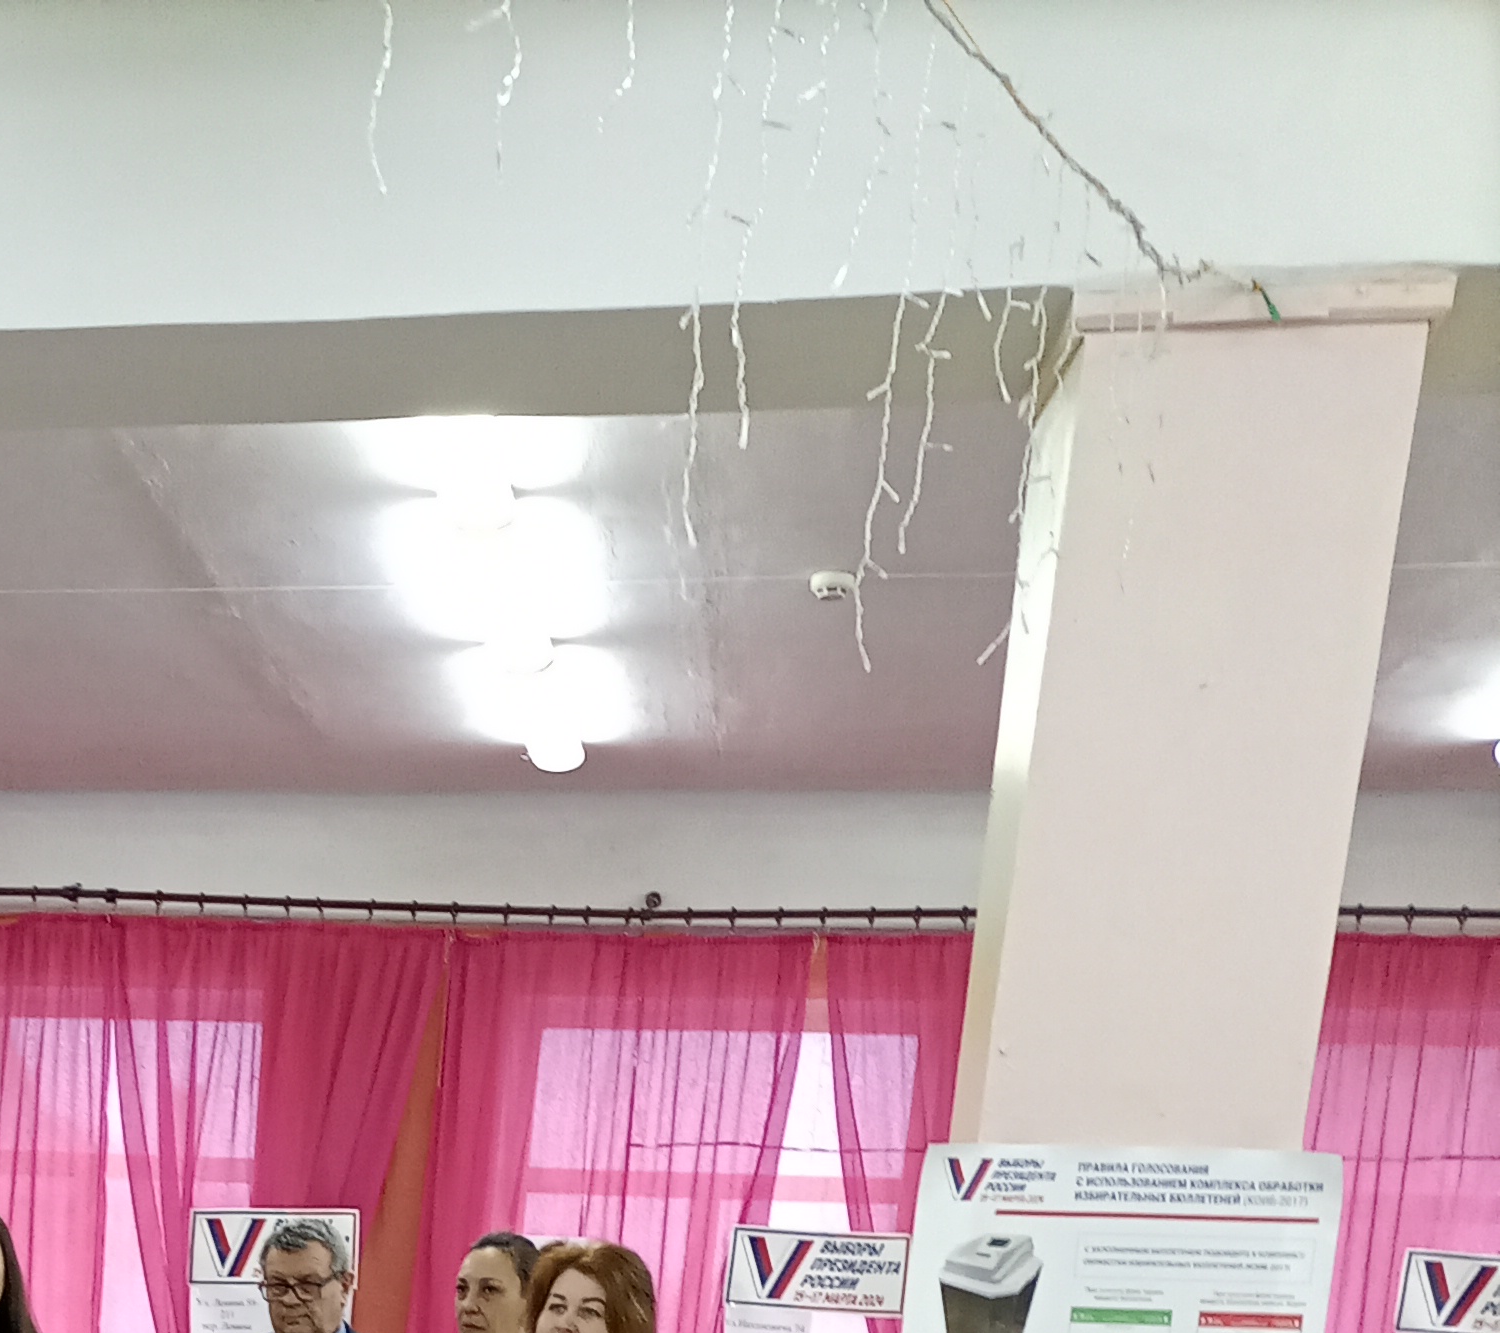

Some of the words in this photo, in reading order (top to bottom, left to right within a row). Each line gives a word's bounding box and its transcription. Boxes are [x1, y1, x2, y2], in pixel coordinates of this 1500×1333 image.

[820, 1240, 885, 1257] ВЫБОРЫ
[810, 1257, 902, 1275] ПРЕЗИДЕНТА
[800, 1274, 860, 1290] РОССИИ
